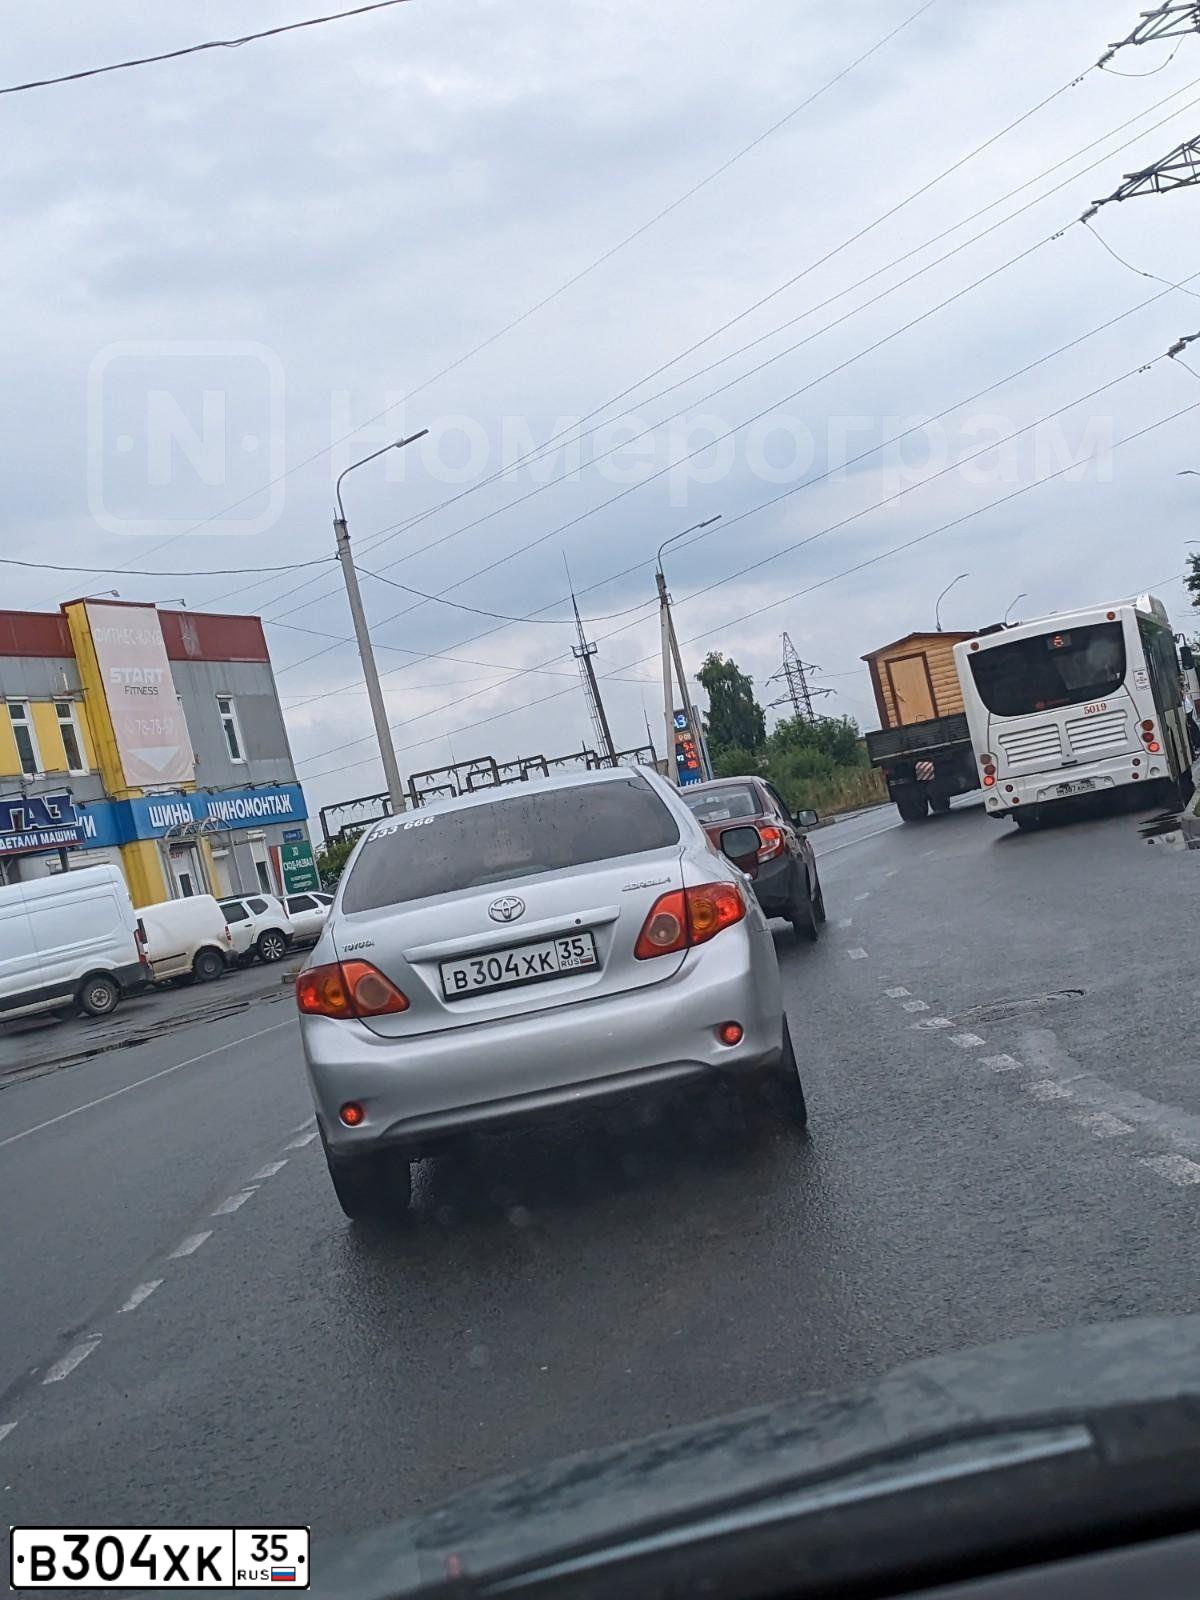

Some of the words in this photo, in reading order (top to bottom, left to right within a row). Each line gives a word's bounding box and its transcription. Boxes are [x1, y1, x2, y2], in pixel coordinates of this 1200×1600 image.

[110, 667, 163, 684] START
[124, 686, 160, 697] FITNESS
[1084, 703, 1107, 715] 5019
[148, 802, 194, 828] ШИНЫ
[207, 794, 293, 823] ШИНОМОНТАЖ
[404, 815, 435, 830] 666
[40, 829, 78, 845] МАШИН
[453, 951, 555, 990] В304ХК
[558, 938, 585, 960] 35
[560, 958, 580, 968] RUS
